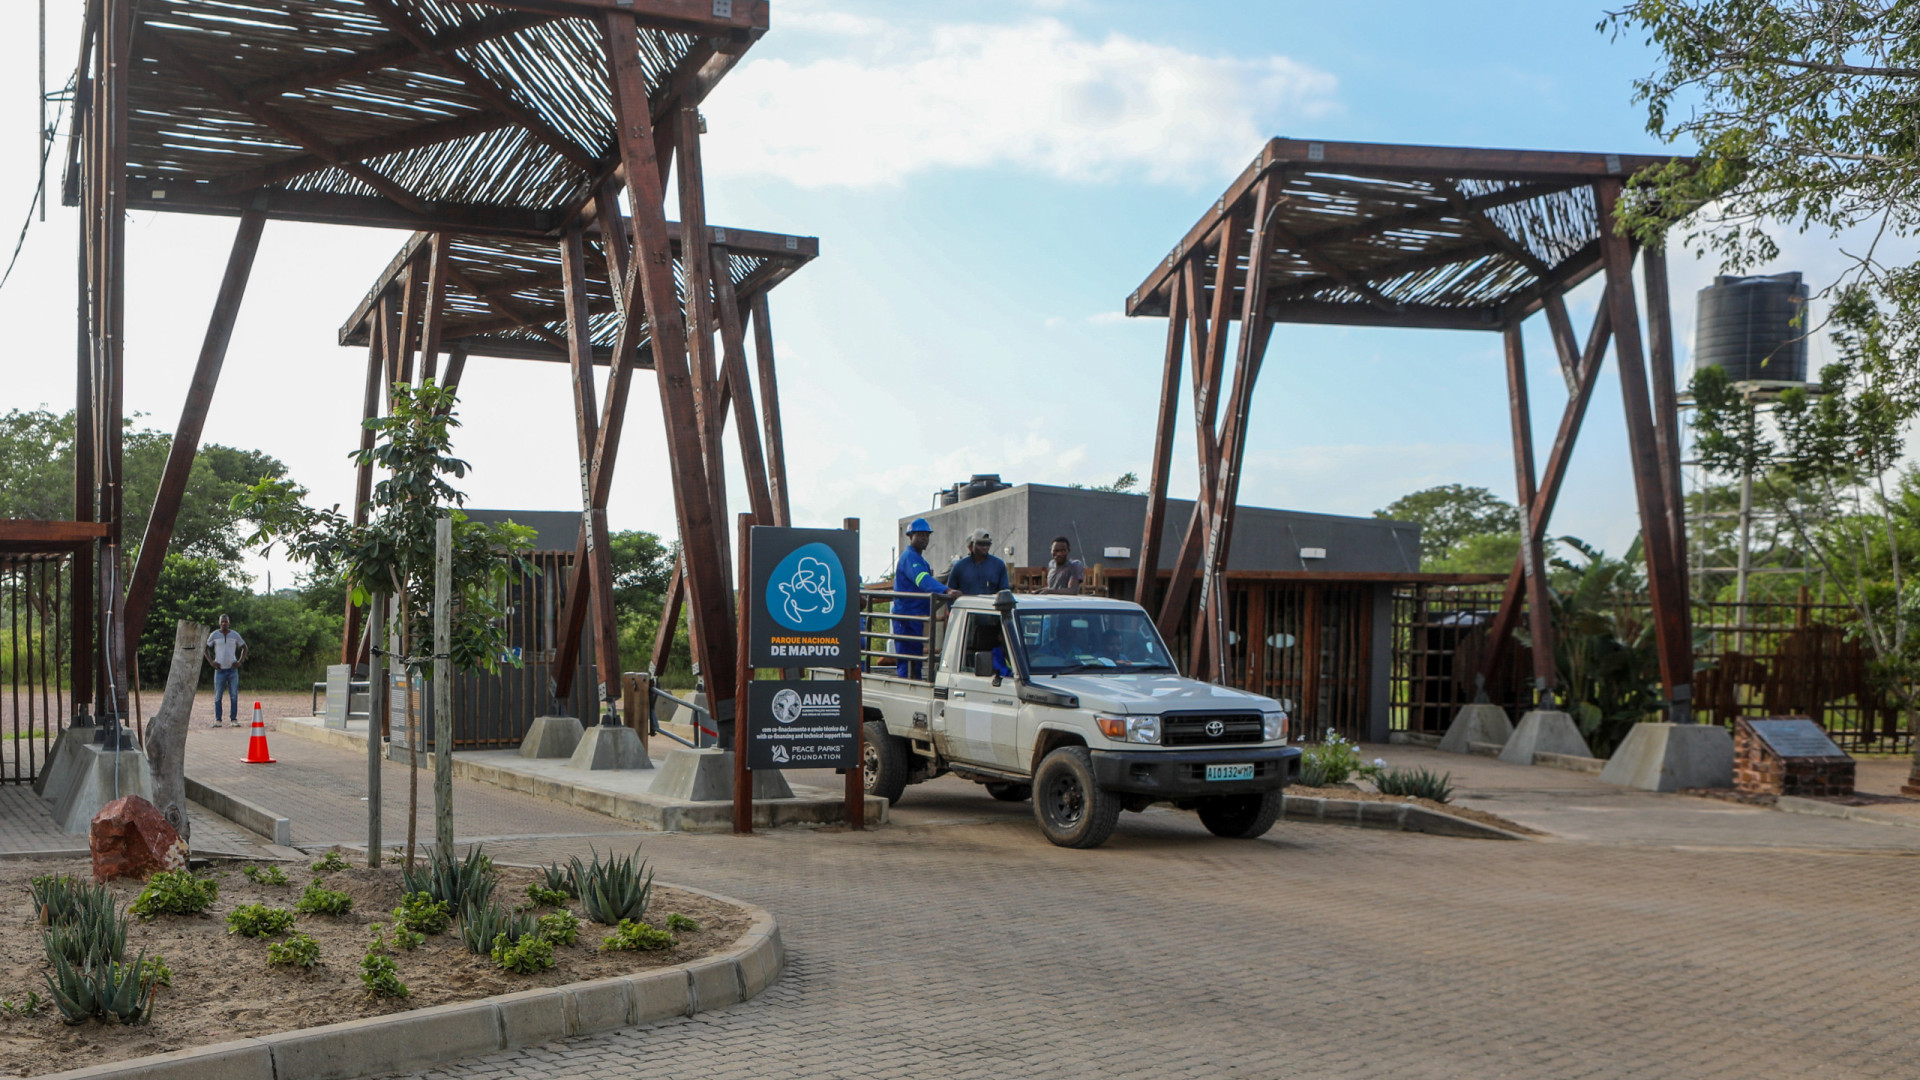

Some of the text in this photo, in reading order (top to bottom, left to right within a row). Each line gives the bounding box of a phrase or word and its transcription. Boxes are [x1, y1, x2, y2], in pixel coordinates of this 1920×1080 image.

[771, 645, 840, 656] DE MAPUTO
[803, 693, 840, 705] ANAC
[768, 733, 794, 741] co-financing
